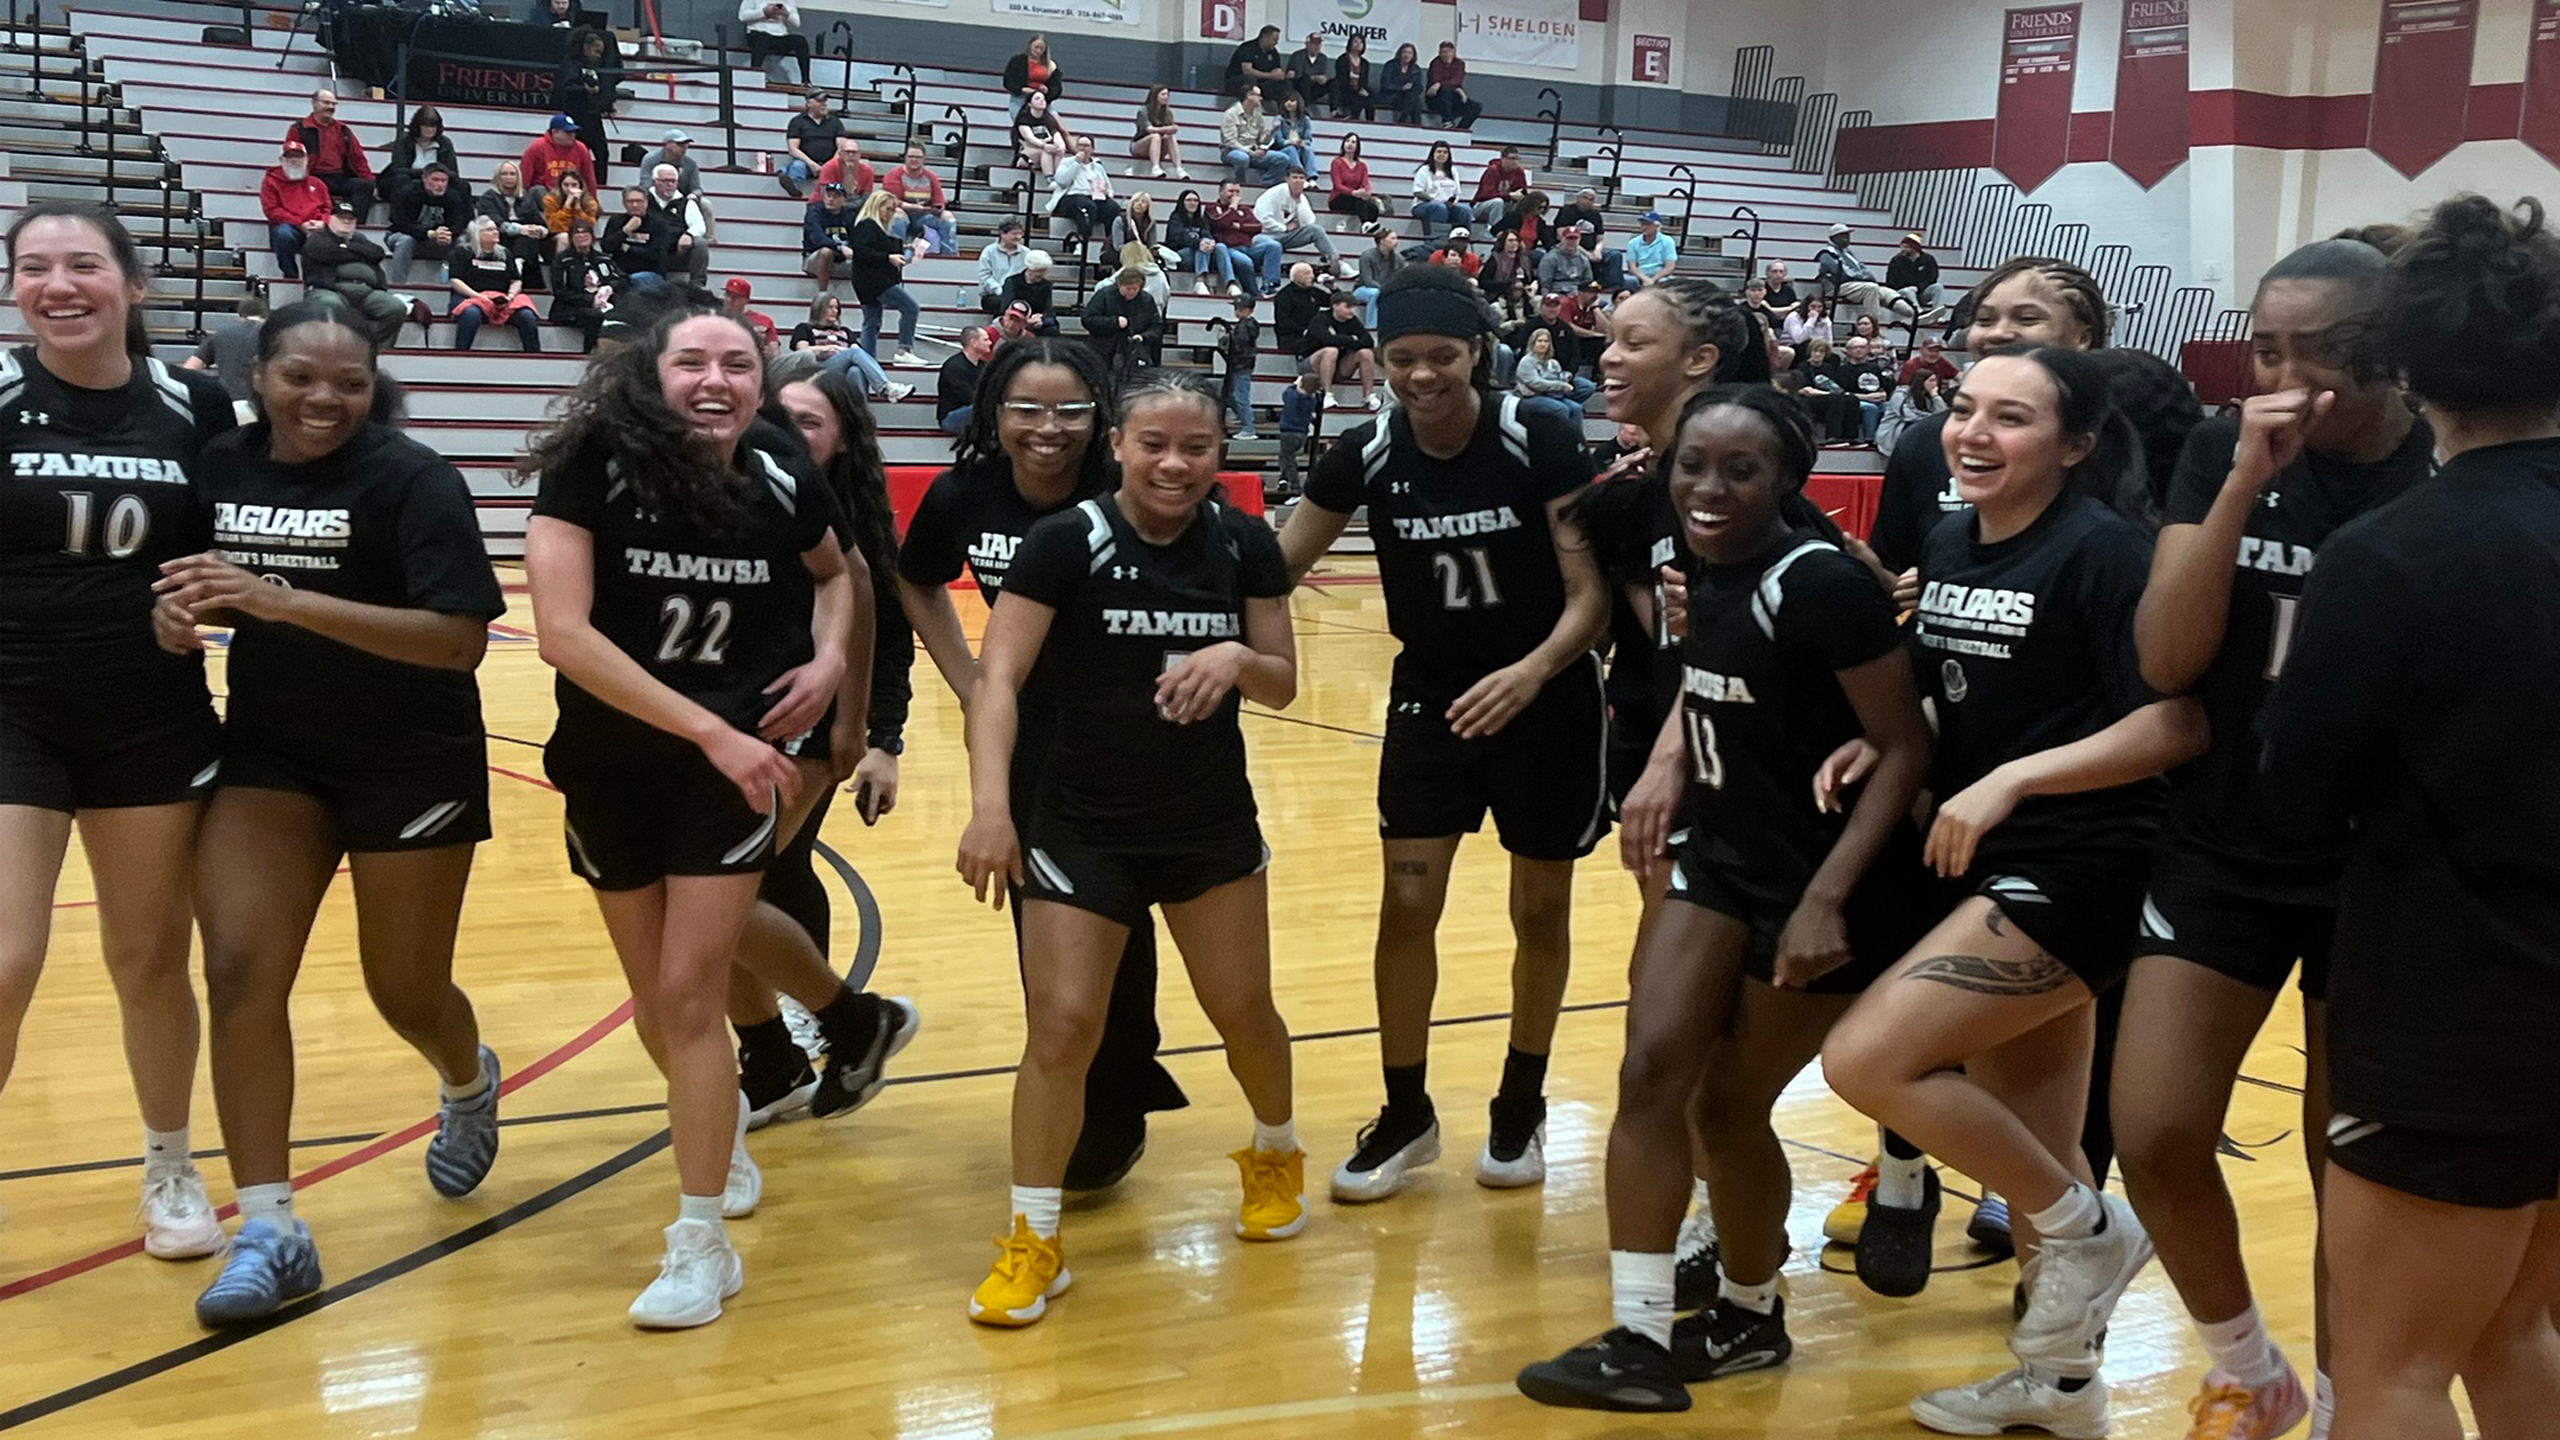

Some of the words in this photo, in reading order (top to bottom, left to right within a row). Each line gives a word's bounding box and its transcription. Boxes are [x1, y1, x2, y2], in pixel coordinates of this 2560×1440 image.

[1213, 4, 1235, 32] D
[1320, 21, 1388, 41] SANDIFER
[1488, 15, 1576, 37] SHELDEN
[2011, 10, 2073, 29] FRIENDS
[439, 63, 555, 92] FRIENDS
[1645, 51, 1661, 76] E
[437, 86, 553, 105] UNIVERSITY
[10, 453, 188, 485] TAMUSA
[59, 491, 150, 560] 10
[1393, 506, 1521, 540] TAMUSA
[625, 547, 771, 584] TAMUSA
[1433, 549, 1503, 609] 21
[655, 594, 733, 664] 22
